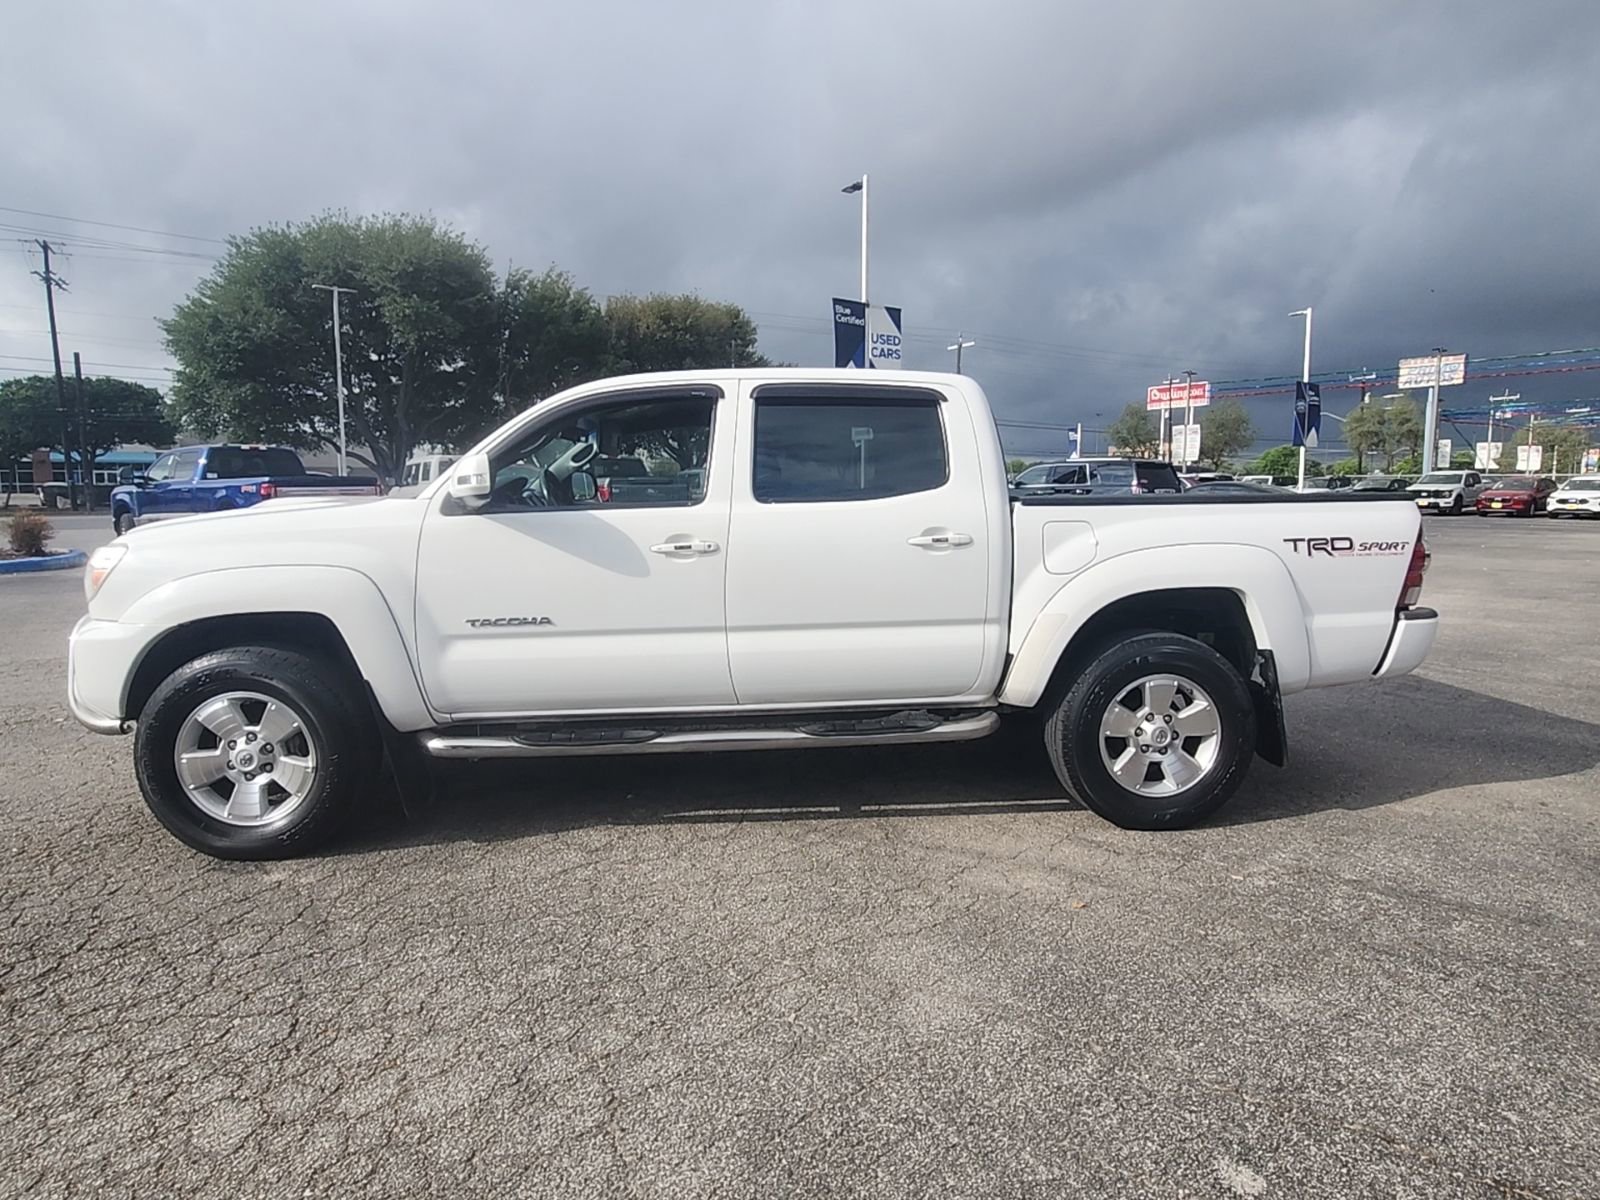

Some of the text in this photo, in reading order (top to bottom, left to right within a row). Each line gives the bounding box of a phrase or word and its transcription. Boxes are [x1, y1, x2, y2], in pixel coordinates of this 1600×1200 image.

[835, 304, 851, 315] Blue
[836, 314, 864, 325] Certified
[871, 333, 901, 346] USED
[871, 347, 901, 360] CARS
[1151, 387, 1204, 400] Burlingon
[1283, 537, 1410, 557] TRD SPORT
[465, 616, 557, 627] TACOMA
